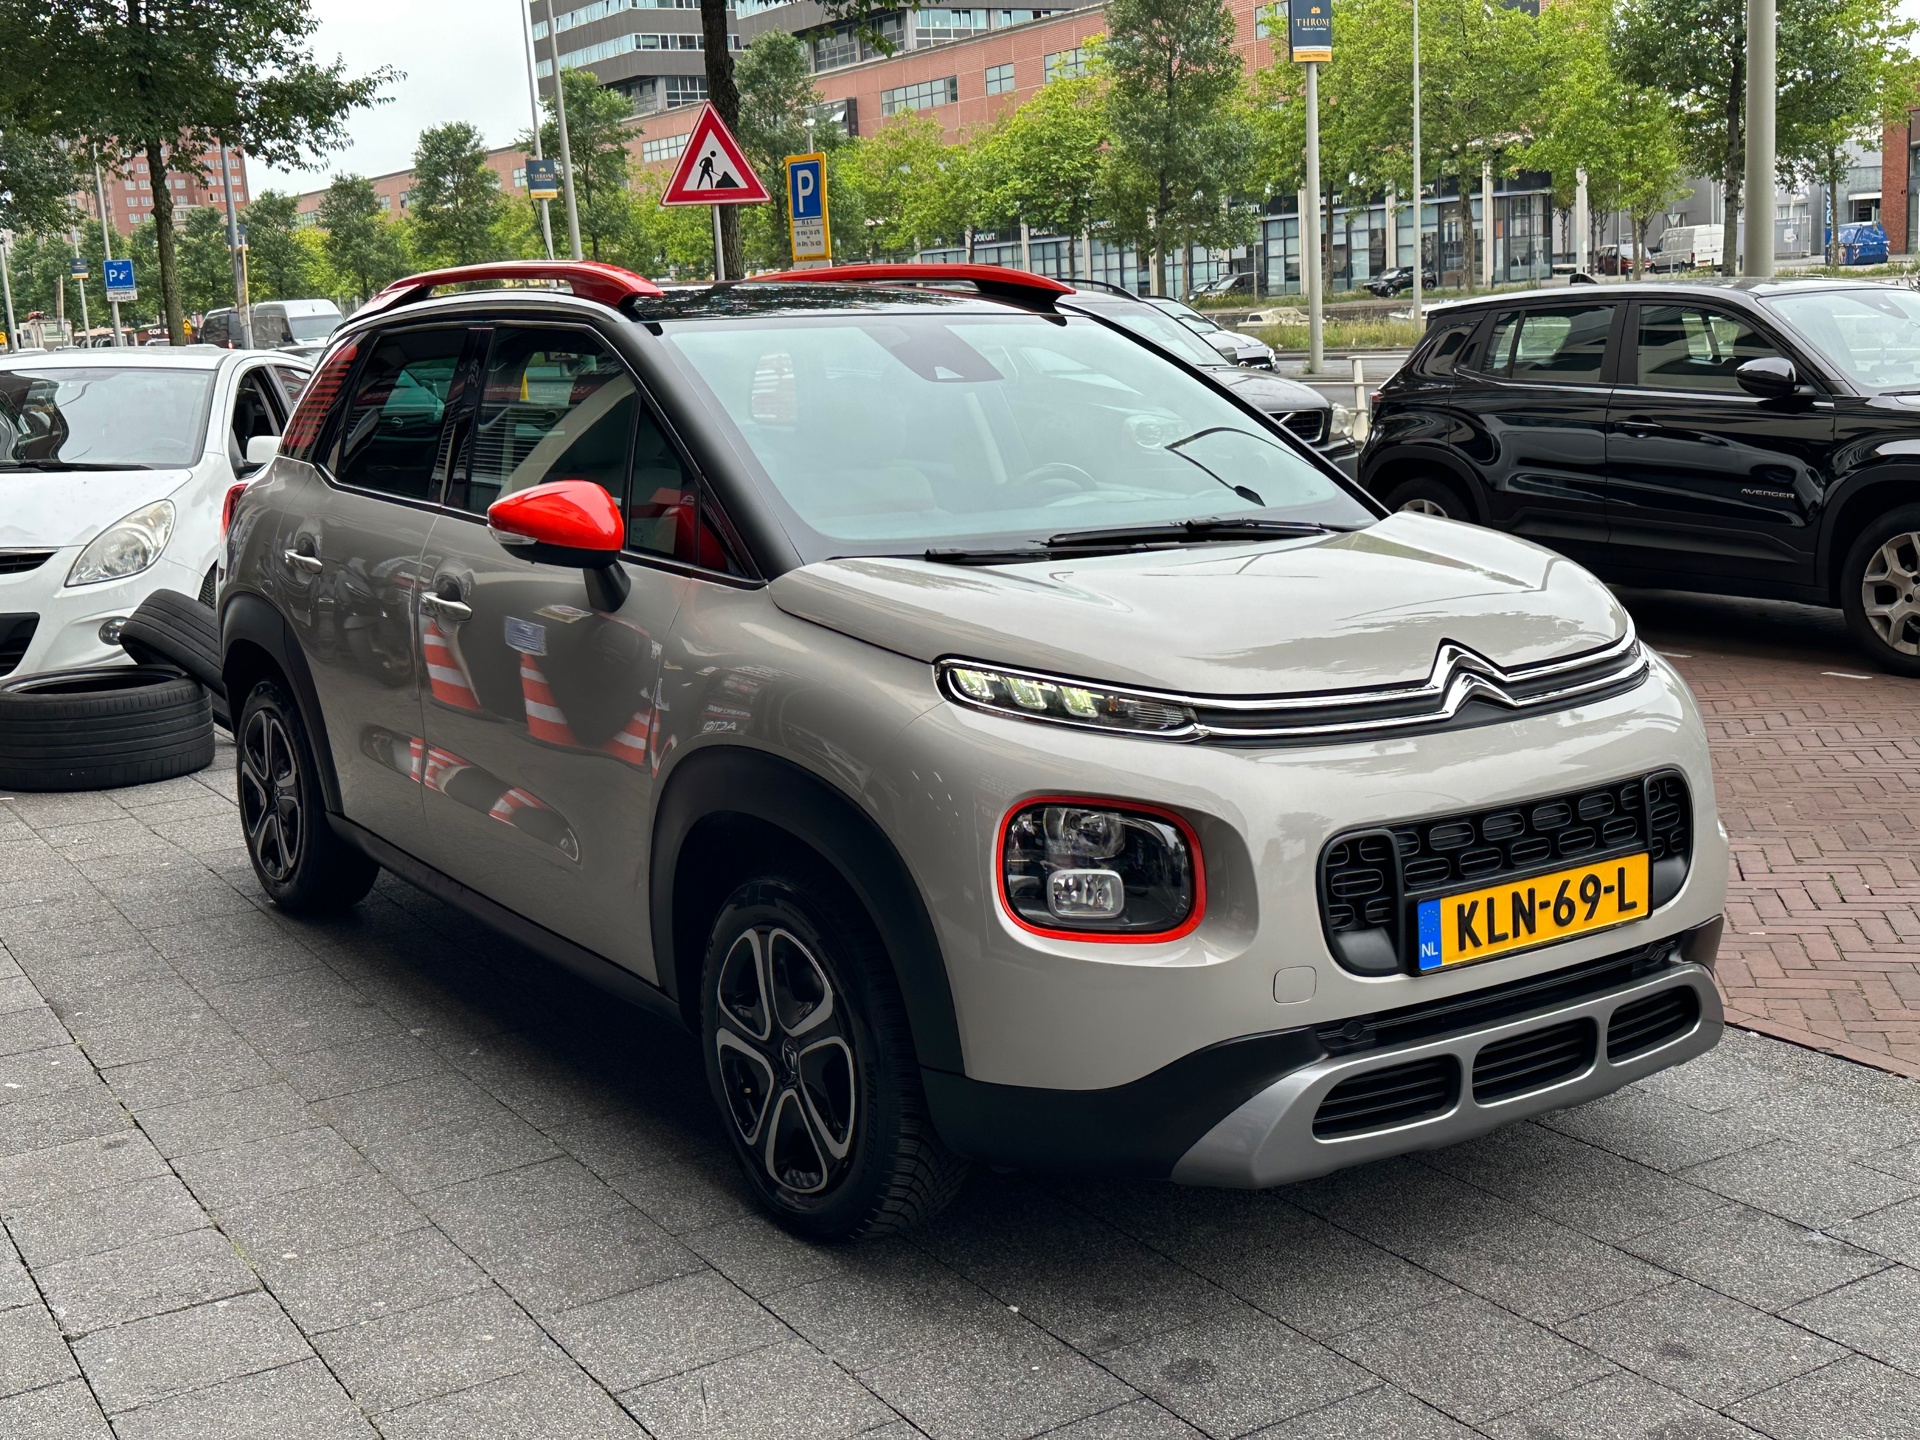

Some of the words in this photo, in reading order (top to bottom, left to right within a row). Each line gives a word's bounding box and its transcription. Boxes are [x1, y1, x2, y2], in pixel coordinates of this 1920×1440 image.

[797, 169, 814, 213] P
[108, 269, 118, 282] P
[1741, 488, 1795, 500] AVENGER
[1457, 867, 1638, 952] KLN-69-L
[1421, 942, 1439, 958] NL
